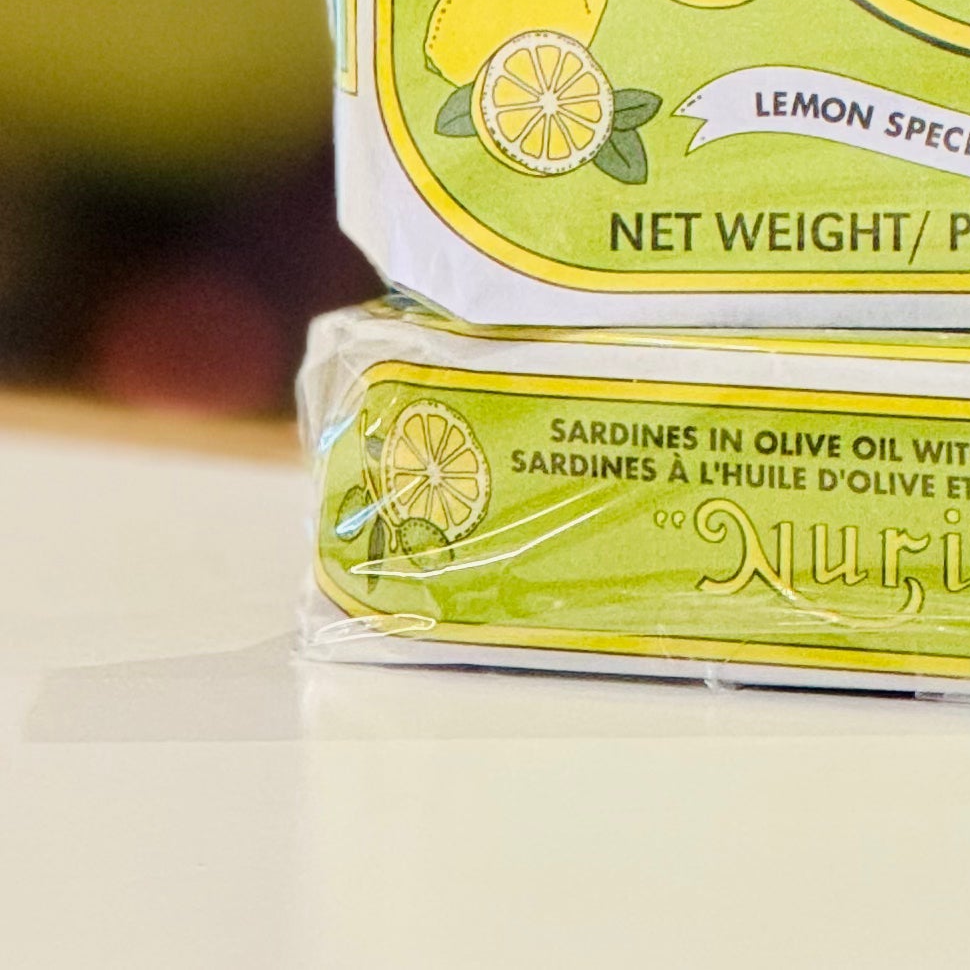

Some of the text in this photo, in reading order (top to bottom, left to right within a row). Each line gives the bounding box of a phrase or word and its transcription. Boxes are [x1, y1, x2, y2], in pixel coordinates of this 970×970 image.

[755, 91, 874, 130] LEMON
[610, 212, 702, 252] NET
[550, 418, 699, 451] SARDINES
[709, 426, 743, 453] IN
[754, 430, 841, 458] OLIVE
[852, 435, 903, 462] OIL
[511, 449, 657, 482] SARDINES
[667, 452, 689, 484] À
[700, 461, 807, 490] L'HUILE
[818, 468, 935, 499] D'OLIVE
